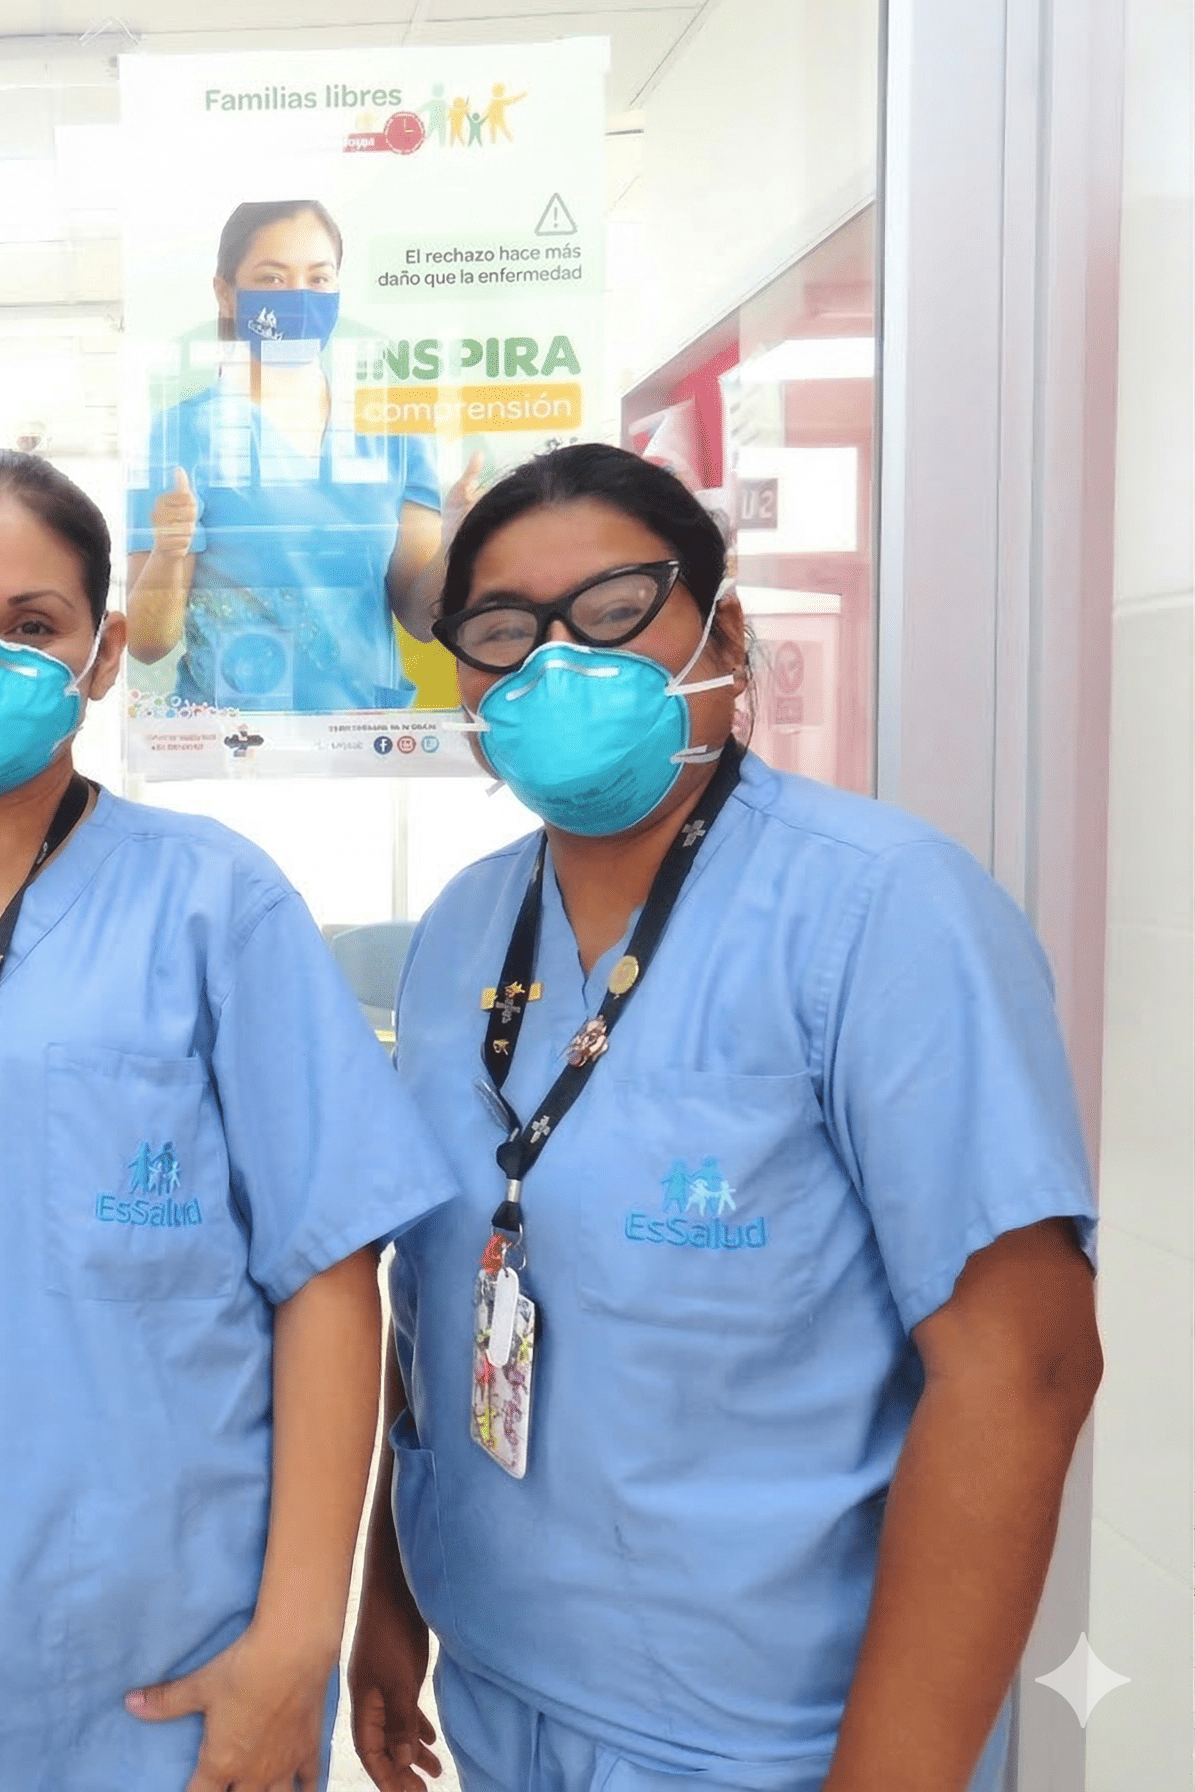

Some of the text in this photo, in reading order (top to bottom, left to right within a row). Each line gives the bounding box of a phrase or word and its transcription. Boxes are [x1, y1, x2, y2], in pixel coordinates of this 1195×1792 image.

[205, 83, 403, 111] Familias libres
[405, 243, 582, 264] El rechazo hace más
[378, 264, 582, 288] daño que la enfermedad
[356, 335, 582, 381] INSPIRA
[362, 393, 572, 426] comprensión
[96, 1194, 202, 1227] EsSalud
[625, 1212, 766, 1249] EsSalud
